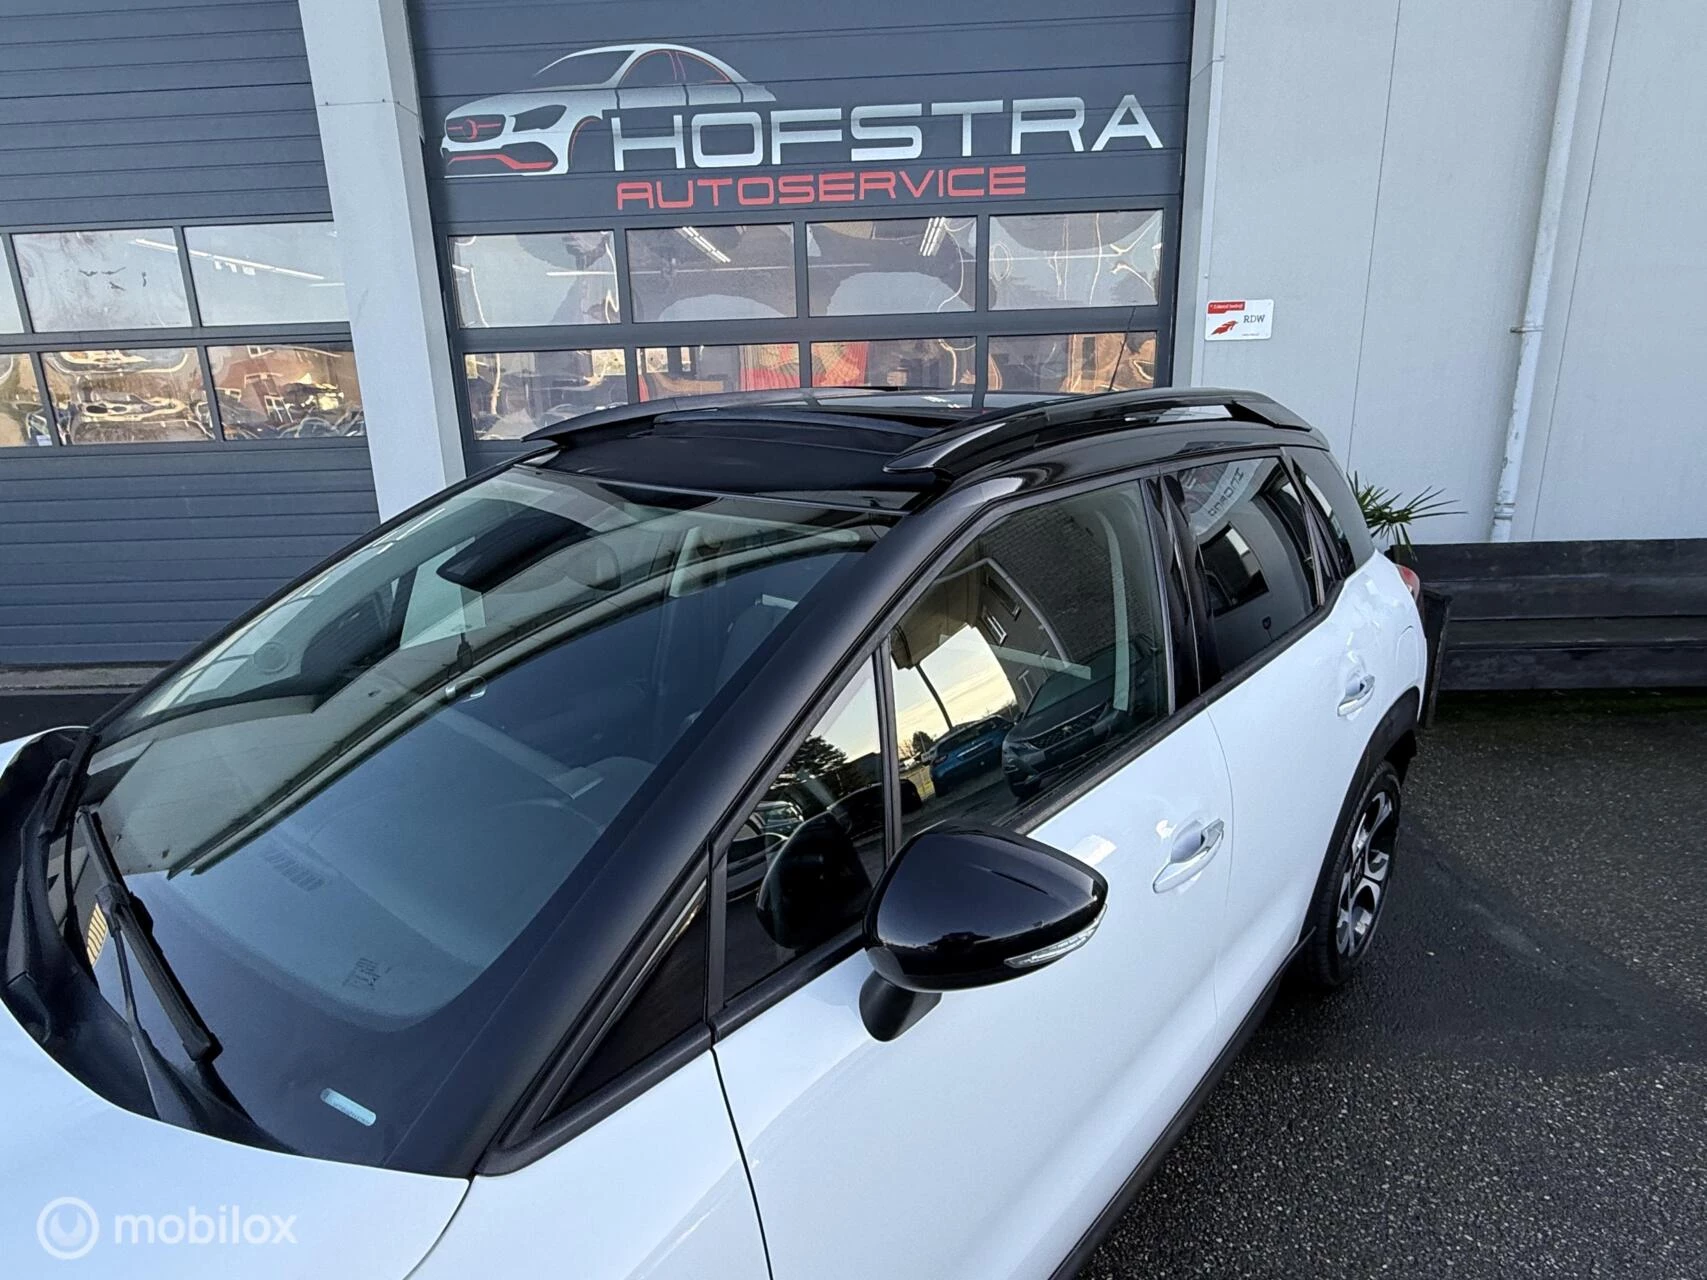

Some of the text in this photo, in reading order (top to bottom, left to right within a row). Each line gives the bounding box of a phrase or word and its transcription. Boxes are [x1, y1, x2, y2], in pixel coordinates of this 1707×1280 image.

[611, 95, 1163, 171] HOFSTRA
[616, 166, 1026, 210] AUTOSERVICE
[1243, 314, 1265, 323] RDW
